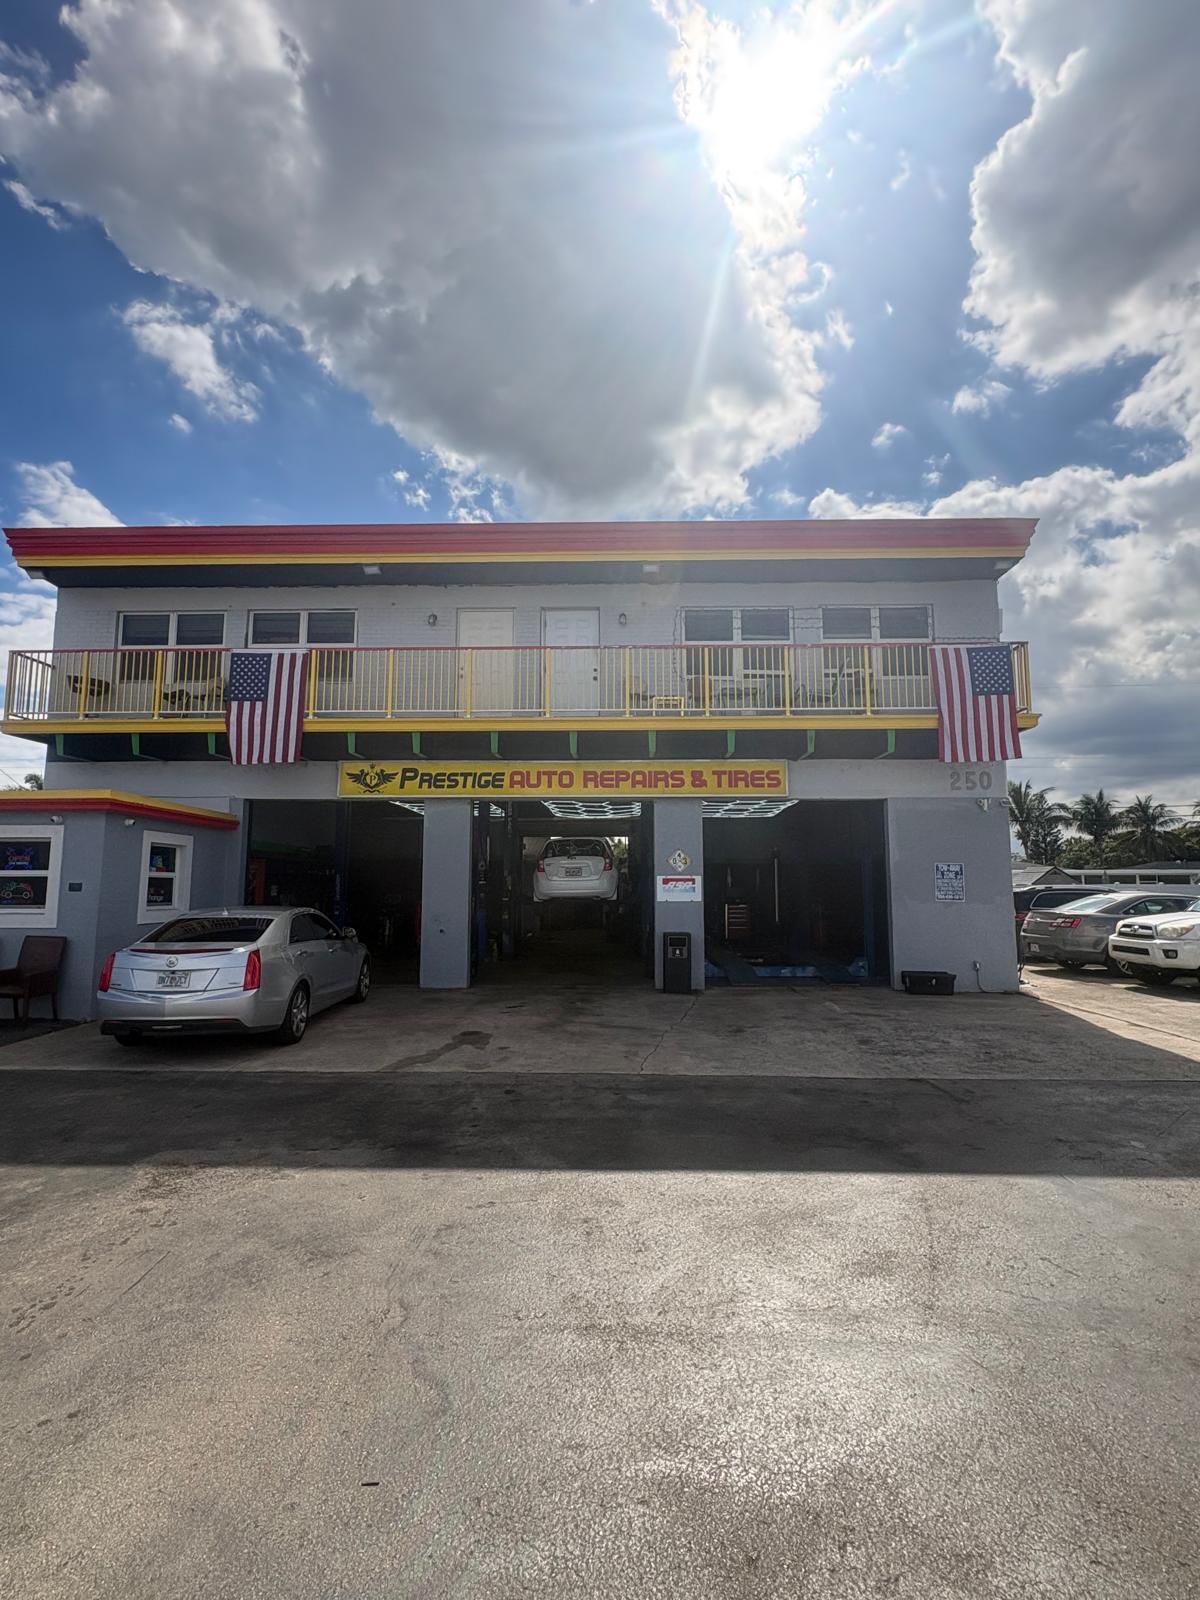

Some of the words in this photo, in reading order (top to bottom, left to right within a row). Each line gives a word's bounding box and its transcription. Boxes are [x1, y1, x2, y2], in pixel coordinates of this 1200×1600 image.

[400, 767, 506, 789] PRESTIGE
[509, 770, 575, 789] AUTO
[583, 770, 685, 788] REPAIRS
[691, 770, 707, 788] &
[712, 770, 782, 788] TIRES
[950, 770, 992, 790] 250
